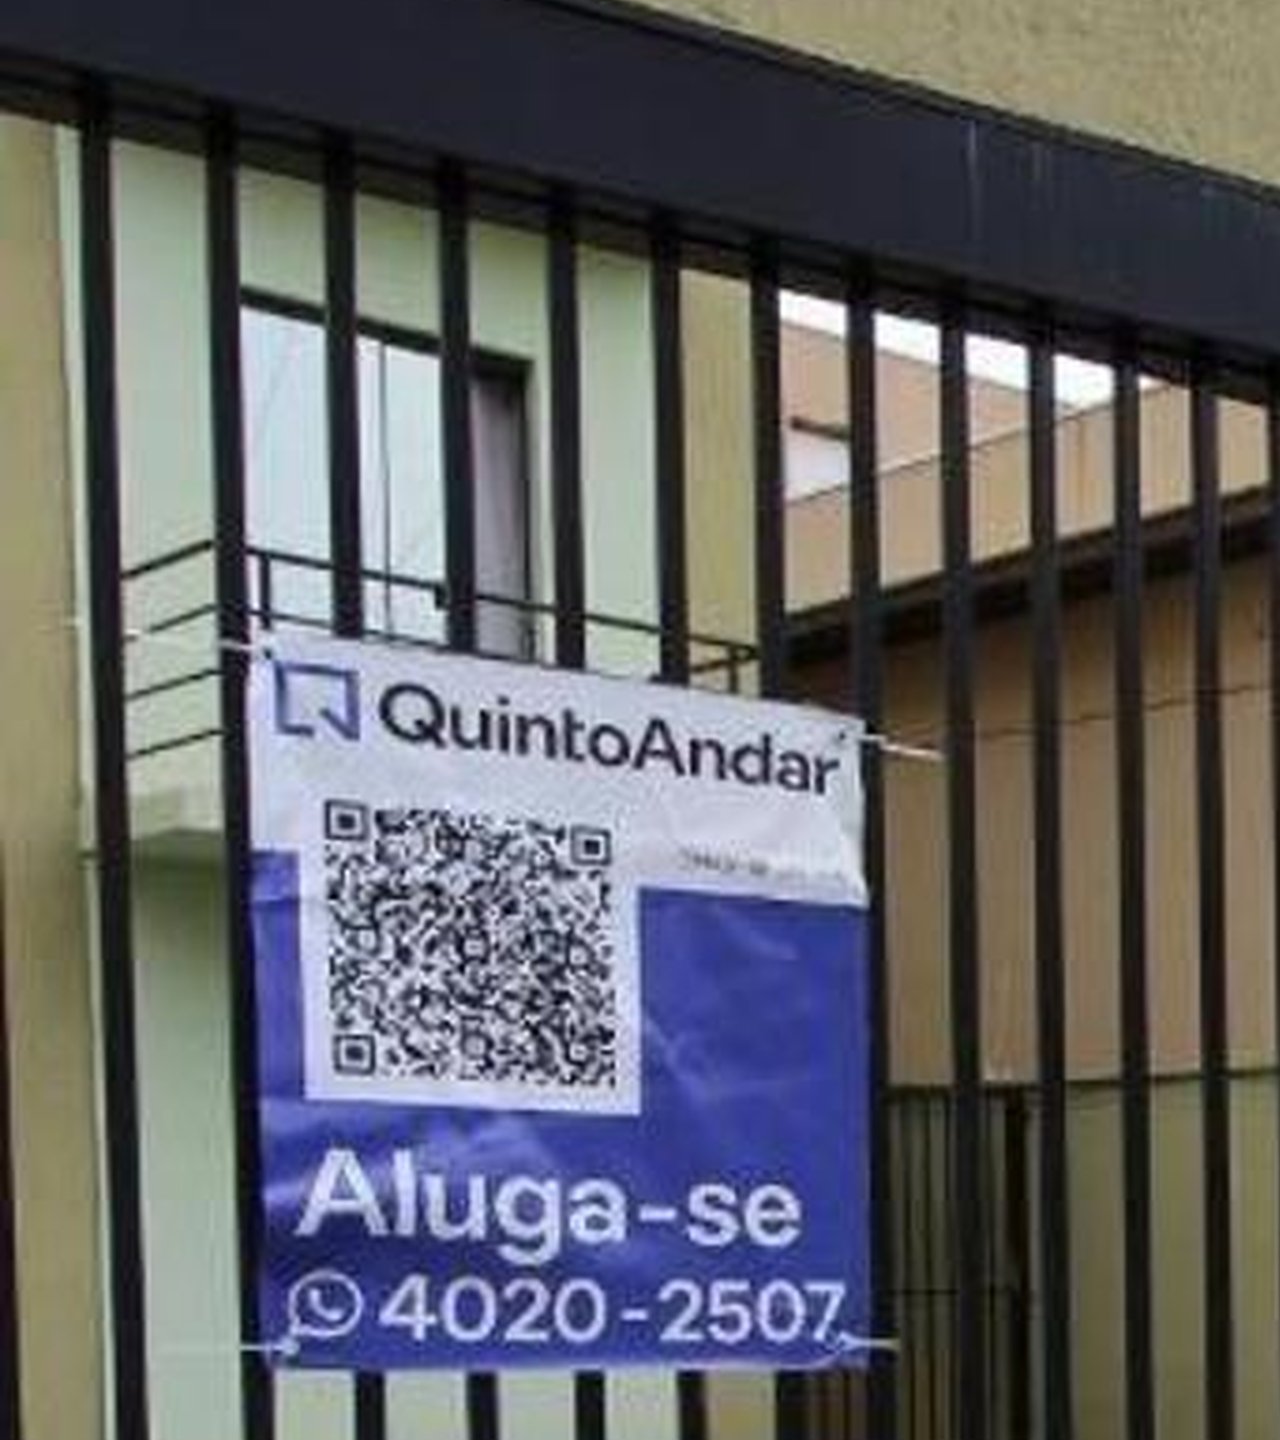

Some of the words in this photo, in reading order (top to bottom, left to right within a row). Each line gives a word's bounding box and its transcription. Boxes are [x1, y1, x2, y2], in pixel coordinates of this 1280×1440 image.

[378, 682, 840, 796] QuintoAndar
[295, 1148, 801, 1266] Aluga-se
[378, 1273, 845, 1344] 4020-2507
